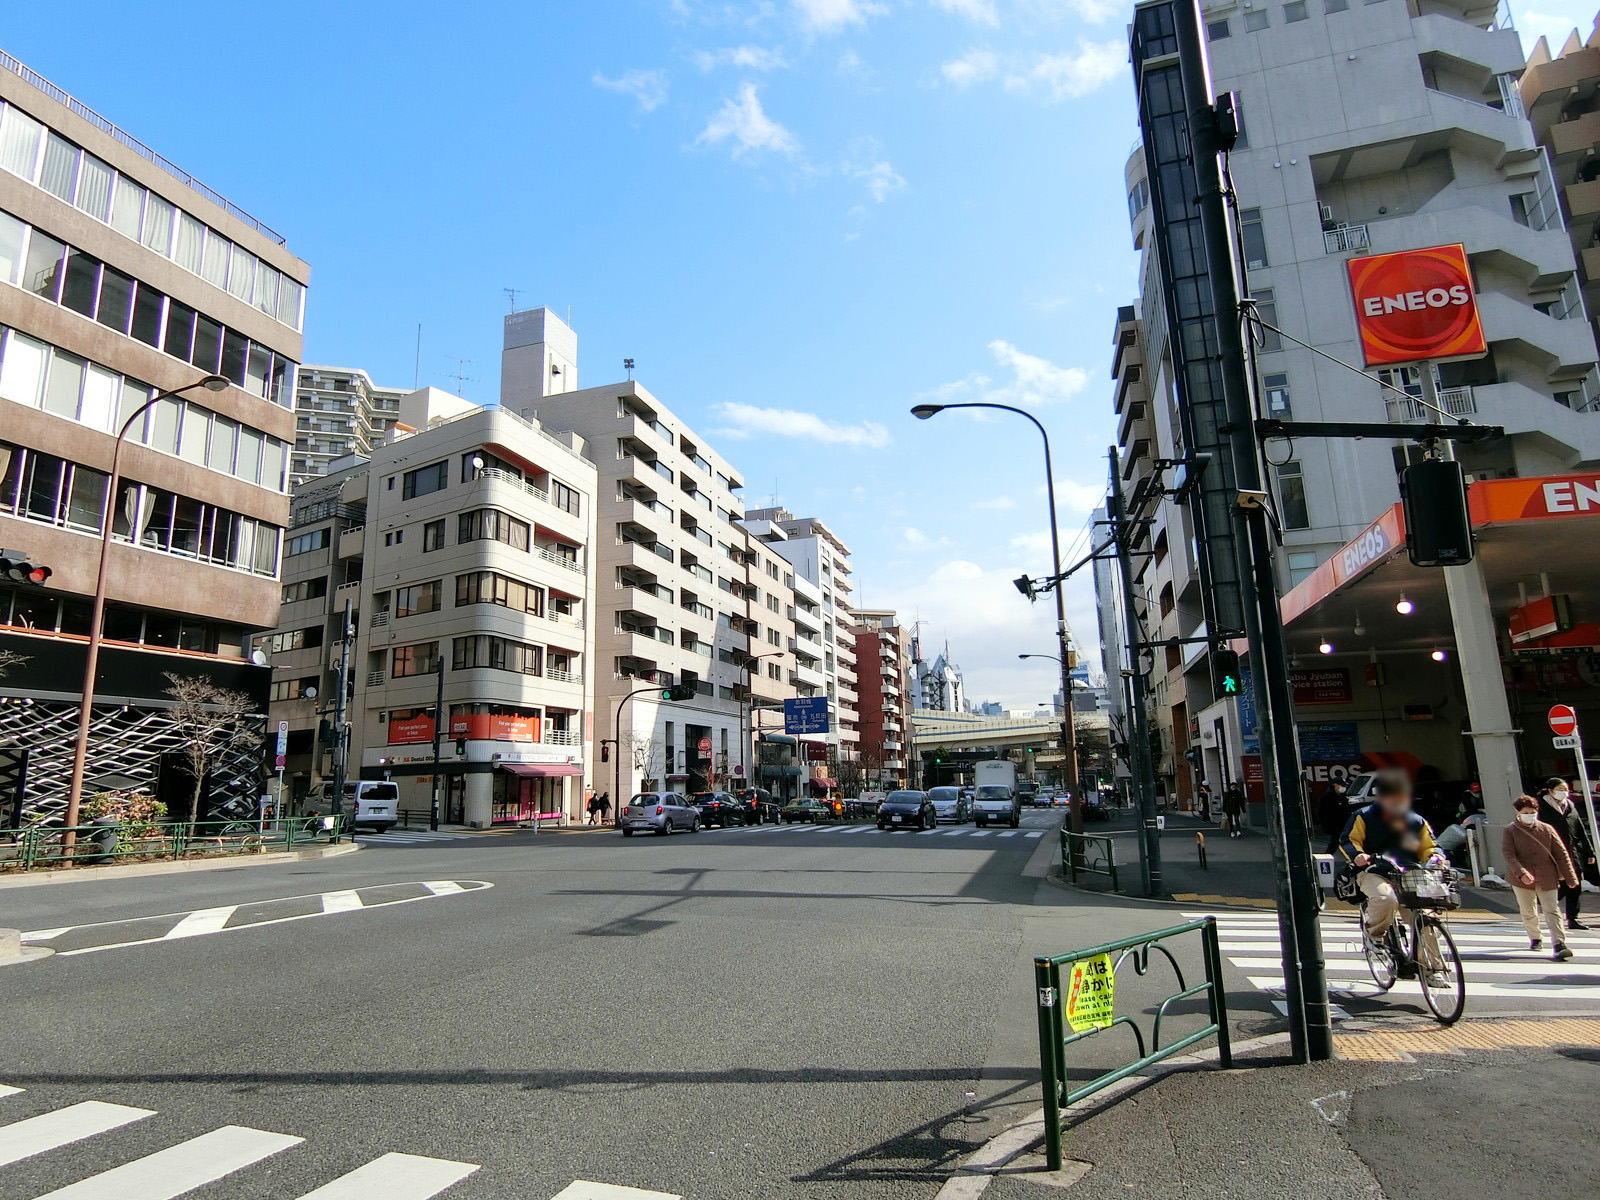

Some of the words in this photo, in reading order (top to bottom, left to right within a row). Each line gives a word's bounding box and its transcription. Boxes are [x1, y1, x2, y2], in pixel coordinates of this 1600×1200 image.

[1363, 285, 1469, 317] ENEOS
[1343, 524, 1383, 576] ENEOS
[1310, 672, 1343, 681] Jyuban
[1313, 680, 1343, 688] station
